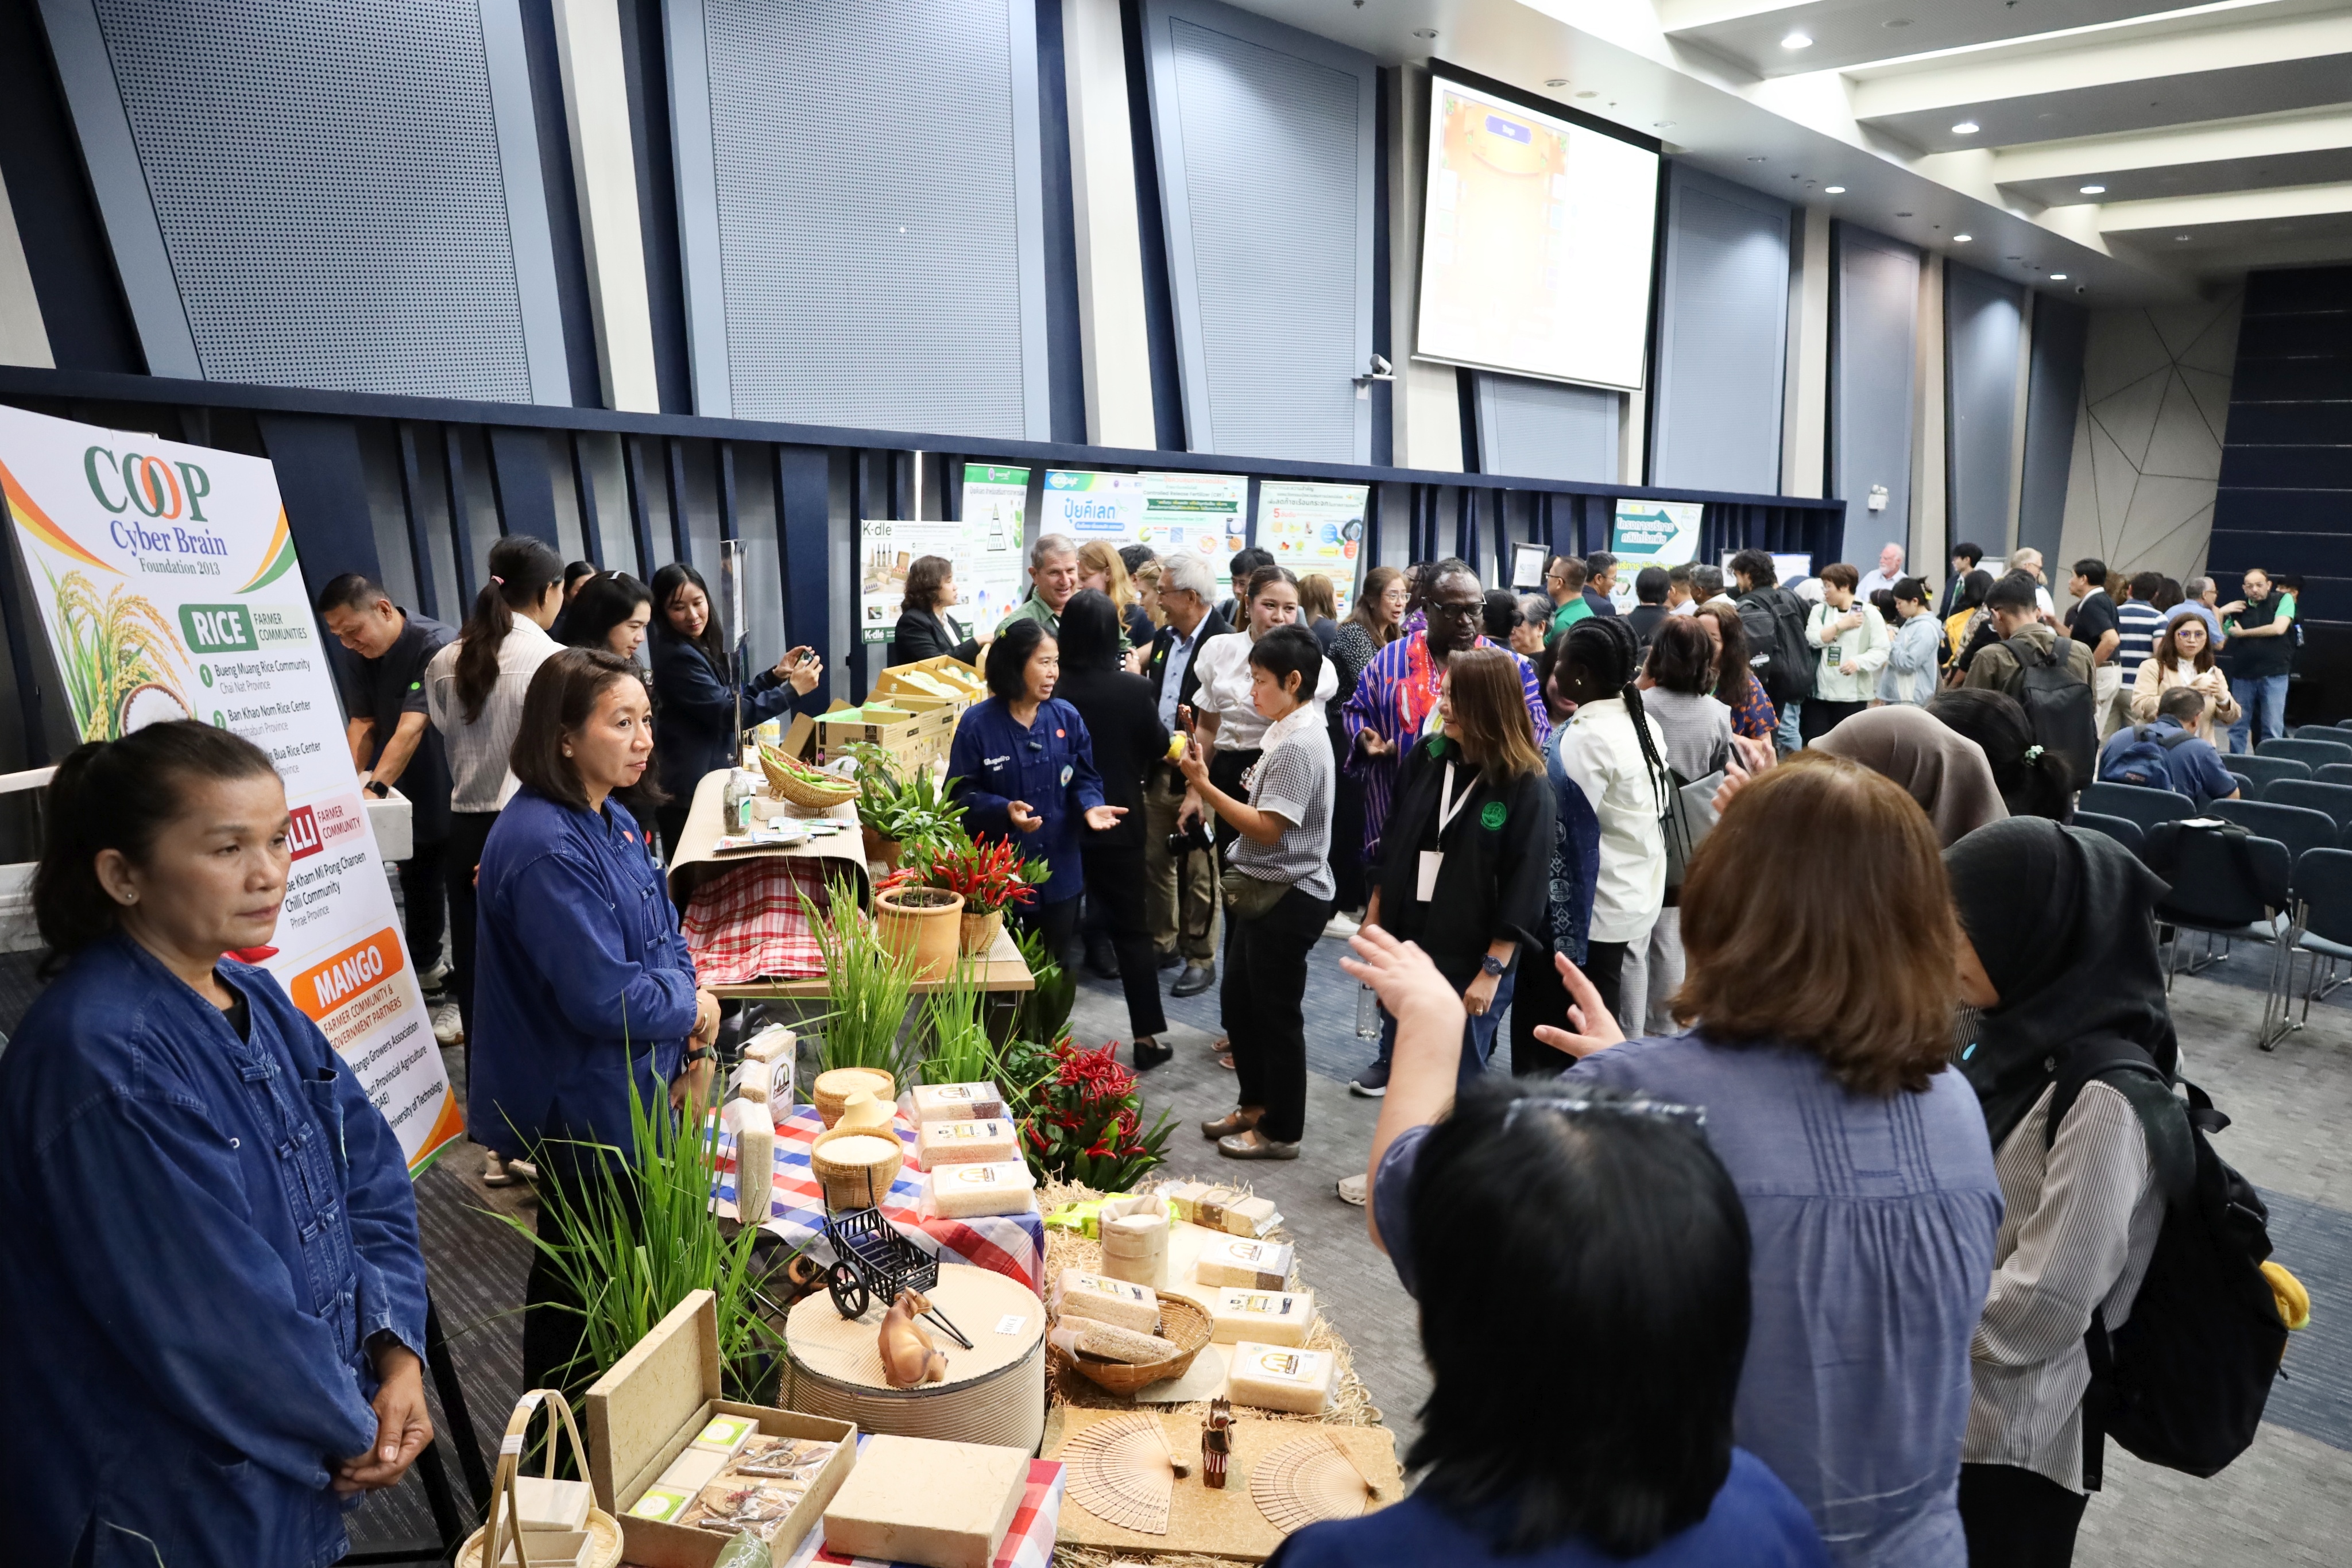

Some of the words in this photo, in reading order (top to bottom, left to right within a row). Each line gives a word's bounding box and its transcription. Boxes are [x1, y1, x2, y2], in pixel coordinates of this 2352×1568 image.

[84, 446, 210, 522] COOP
[1065, 497, 1115, 524] ปุ๋ยคีเลต
[1274, 508, 1280, 518] 5
[1617, 517, 1674, 531] โครงการบริการ
[110, 520, 171, 556] Cyber
[172, 526, 229, 556] Brain
[1622, 532, 1666, 543] คลินิกโรคพืช
[138, 557, 196, 574] Foundation
[197, 561, 220, 575] 2013
[191, 611, 247, 645] RICE
[253, 613, 284, 625] FARMER
[258, 628, 307, 641] COMMUNITIES
[203, 669, 210, 683] 1
[214, 664, 238, 678] Bueng
[238, 661, 260, 676] Muang
[260, 660, 274, 673] Rice
[274, 658, 311, 672] Community
[220, 680, 234, 694] Chai
[234, 680, 246, 693] Nat
[246, 679, 271, 692] Province
[227, 709, 242, 722] Ban
[242, 706, 260, 719] Khao
[260, 704, 277, 717] Nom
[276, 702, 291, 714] Rice
[290, 700, 311, 713] Center
[233, 723, 265, 738] Ratchaburi
[265, 721, 289, 733] Province
[273, 748, 287, 760] Bua
[286, 745, 301, 758] Rice
[300, 741, 321, 754] Center
[276, 764, 300, 776] Province
[317, 805, 344, 823] FARMER
[322, 816, 362, 839] COMMUNITY
[286, 880, 296, 893] ae
[295, 873, 316, 888] Kham
[315, 865, 325, 880] Mi
[323, 862, 342, 876] Pong
[340, 852, 367, 870] Charoen
[285, 895, 303, 913] Chilli
[303, 881, 341, 905] Community
[290, 914, 308, 930] Phrae
[306, 905, 330, 922] Province
[313, 945, 383, 1008] MANGO
[323, 1010, 351, 1036] FARMER
[351, 987, 388, 1018] COMMUNITY
[388, 984, 394, 995] &
[372, 996, 402, 1024] PARTNERS
[369, 1040, 392, 1062] Growers
[391, 1020, 420, 1047] Association
[375, 1062, 401, 1090] Provincial
[400, 1045, 427, 1072] Agriculture
[412, 1097, 419, 1112] of
[416, 1079, 443, 1106] Technology
